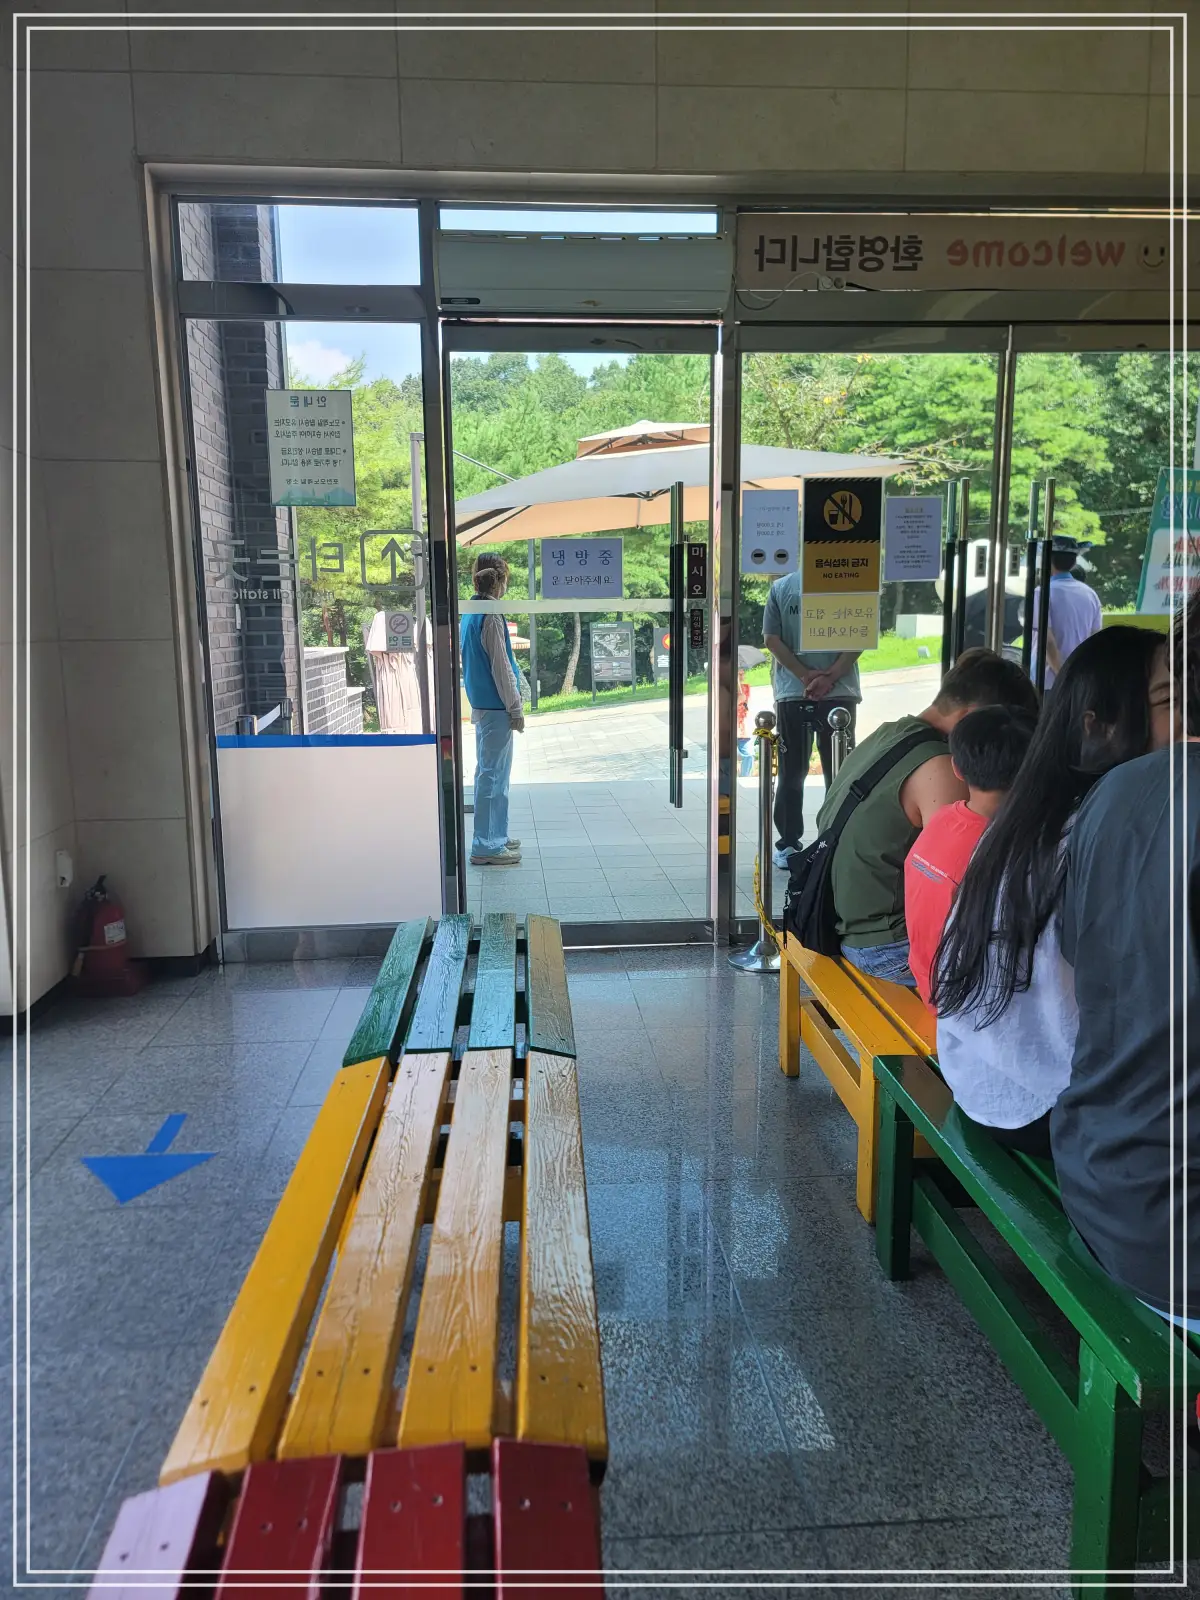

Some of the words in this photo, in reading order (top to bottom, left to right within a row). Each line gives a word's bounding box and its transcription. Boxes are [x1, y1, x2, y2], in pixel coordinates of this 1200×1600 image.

[691, 546, 704, 595] 미시오
[815, 558, 849, 568] 음식섭취
[851, 558, 869, 567] 금지
